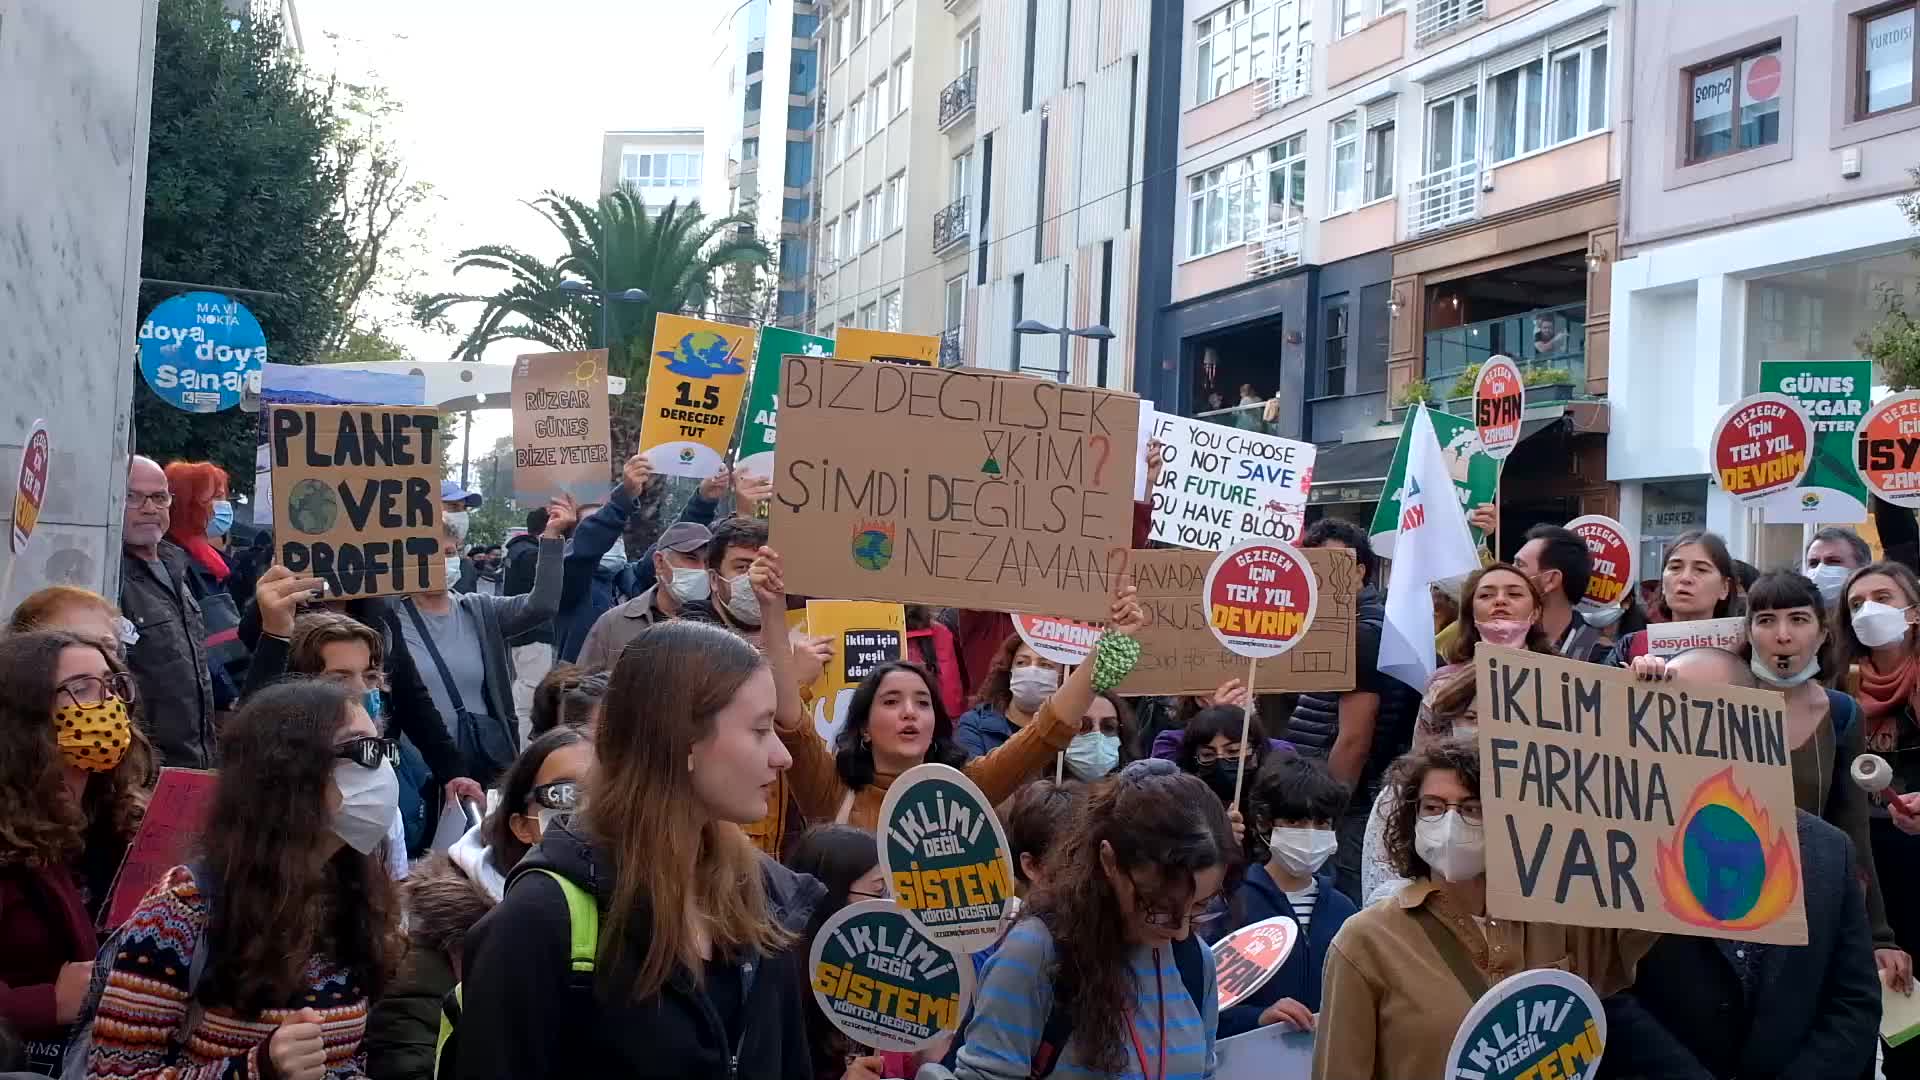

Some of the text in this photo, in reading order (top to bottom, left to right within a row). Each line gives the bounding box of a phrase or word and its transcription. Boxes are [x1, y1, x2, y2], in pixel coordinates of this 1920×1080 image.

[139, 320, 205, 348] doya
[197, 314, 240, 326] NOKTA
[195, 340, 268, 371] doya
[525, 388, 592, 411] RÜZGAR
[675, 381, 720, 410] 1.5
[786, 359, 864, 410] BİZ
[1779, 373, 1854, 397] GÜNEŞ
[660, 407, 725, 426] DERECEDE
[1476, 391, 1521, 427] İSYAN
[1733, 405, 1787, 429] GEZEGEN
[274, 409, 438, 467] PLANET
[535, 416, 589, 440] GÜNEŞ
[680, 425, 705, 438] TUT
[1153, 418, 1295, 464] IF YOU CHOOSE
[1748, 420, 1772, 440] İÇİN
[516, 444, 608, 467] BİZE YETER
[1729, 434, 1794, 463] TEK YOL
[1154, 470, 1178, 489] UR
[1191, 450, 1231, 474] NOT
[1237, 460, 1295, 488] SAVE
[1721, 450, 1805, 491] DEVRİM
[777, 459, 910, 519] ŞİMDİ
[1153, 492, 1295, 541] OU HAVE BLOOD
[1151, 519, 1166, 536] N
[1178, 524, 1222, 550] YOUR
[1577, 526, 1621, 548] GEZEGEN
[282, 537, 439, 598] PROFIT
[1235, 550, 1293, 572] GEZEGEN
[1248, 565, 1276, 584] İÇİN
[1226, 583, 1295, 607] TEK YOL
[1211, 603, 1305, 636] DEVRİM
[1651, 632, 1714, 652] sosyalist
[1489, 658, 1787, 766] İKLİM KRİZİNİN
[1491, 738, 1675, 825] FARKINA
[888, 790, 986, 855] İKLİMİ
[922, 829, 966, 857] DEĞİL
[1505, 814, 1644, 912] VAR
[892, 847, 1010, 910] SİSTEMİ
[831, 925, 955, 981] İKLİMİ
[866, 953, 915, 983] DEĞİL
[813, 963, 960, 1031] SİSTEMİ
[1495, 1033, 1547, 1075] DEĞİL
